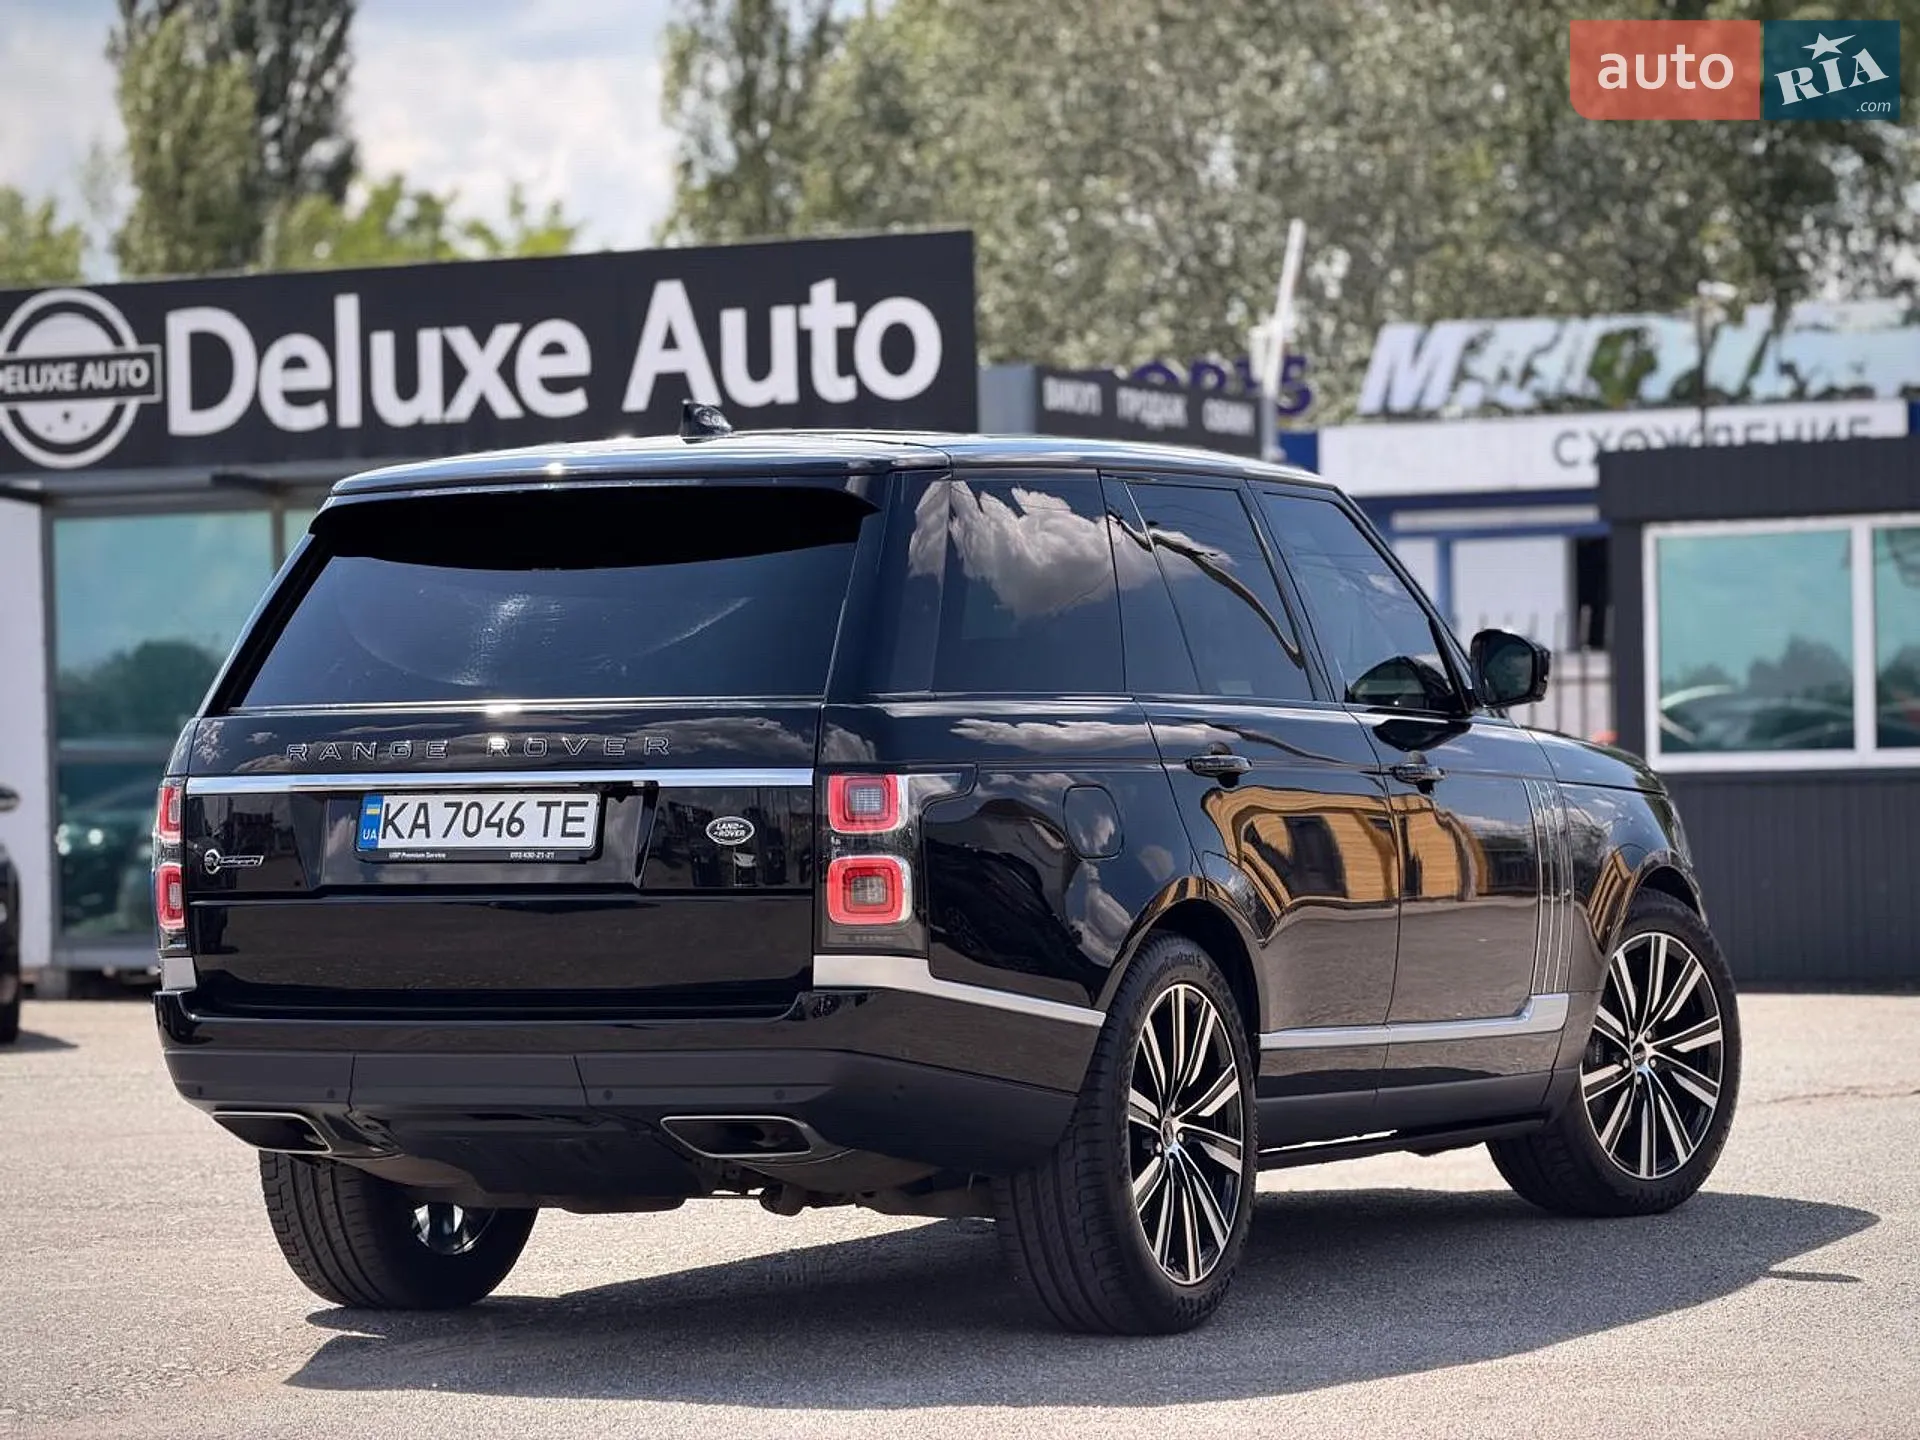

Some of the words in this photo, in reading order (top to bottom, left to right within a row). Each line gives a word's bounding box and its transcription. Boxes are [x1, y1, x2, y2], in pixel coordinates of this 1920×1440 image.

[166, 293, 592, 436] Deluxe
[622, 277, 943, 413] Auto
[80, 358, 150, 390] AUTO
[286, 740, 449, 761] RANGE
[487, 736, 670, 759] ROVER
[362, 829, 378, 841] UA
[381, 802, 432, 840] KA
[442, 801, 526, 839] 7046
[536, 801, 590, 838] TE
